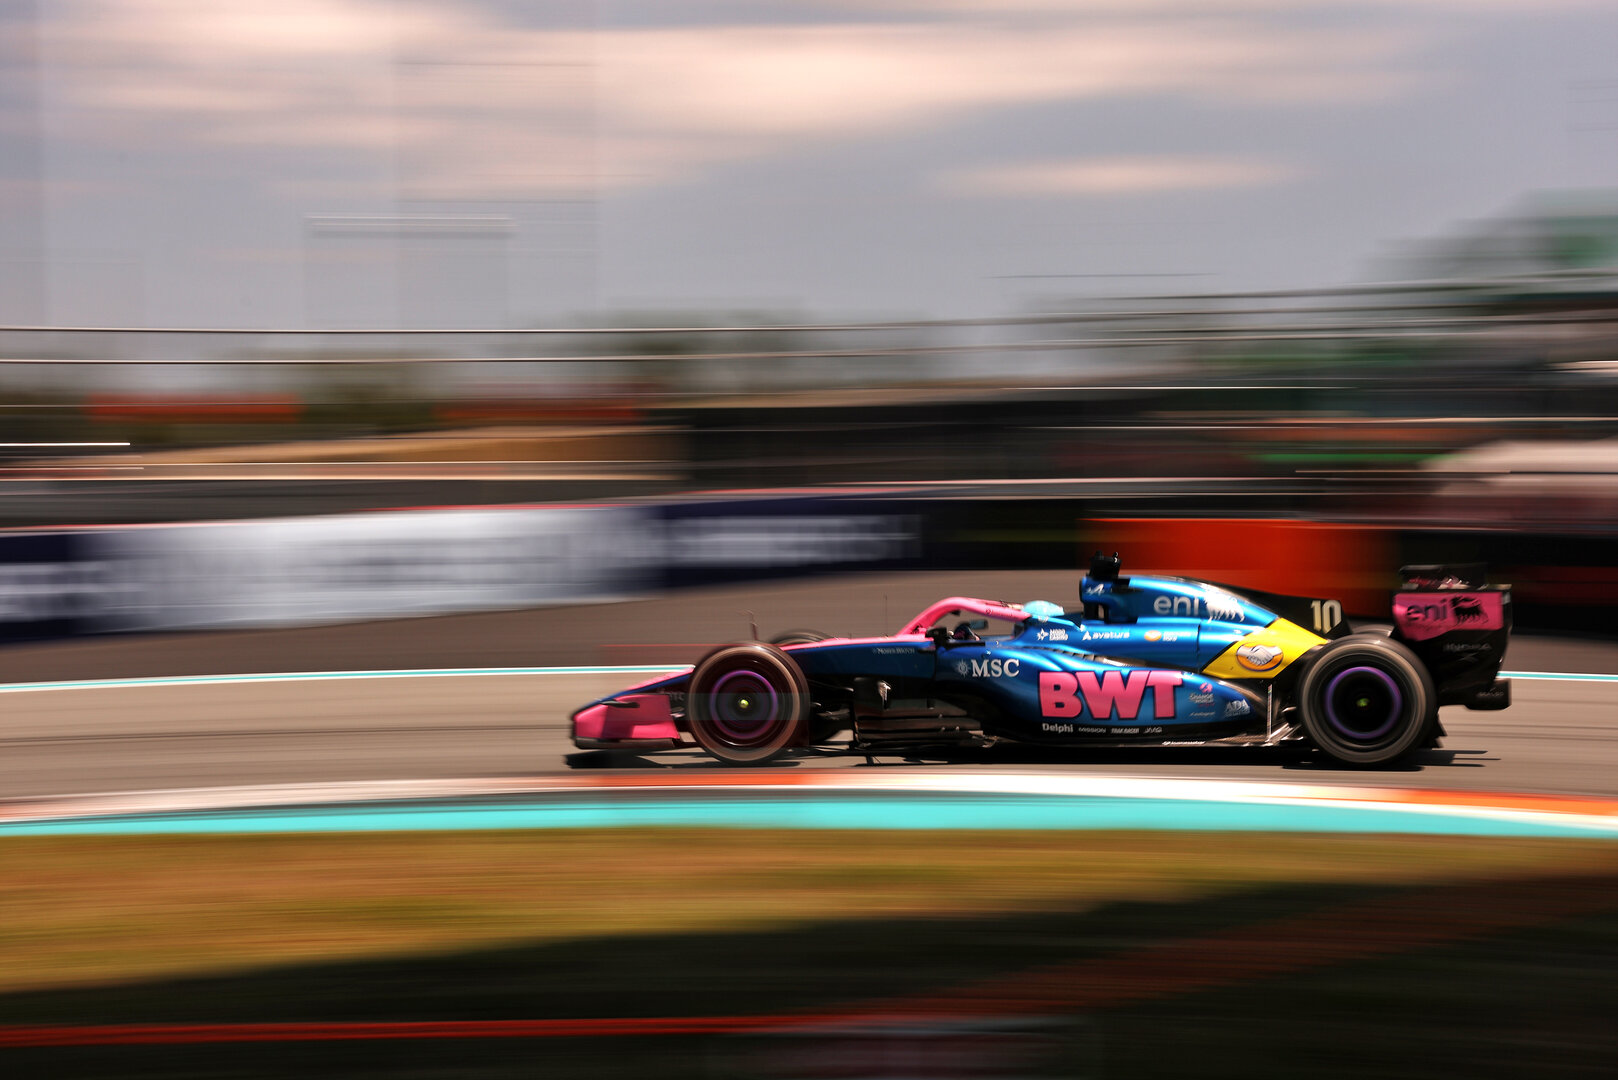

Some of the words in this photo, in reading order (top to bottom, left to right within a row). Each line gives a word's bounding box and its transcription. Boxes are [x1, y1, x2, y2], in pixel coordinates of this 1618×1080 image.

[1153, 594, 1200, 616] eni
[1406, 599, 1448, 621] eni
[1311, 600, 1342, 634] 10
[971, 659, 1020, 678] MSC
[1038, 670, 1184, 720] BWT
[1042, 723, 1074, 733] Delphi
